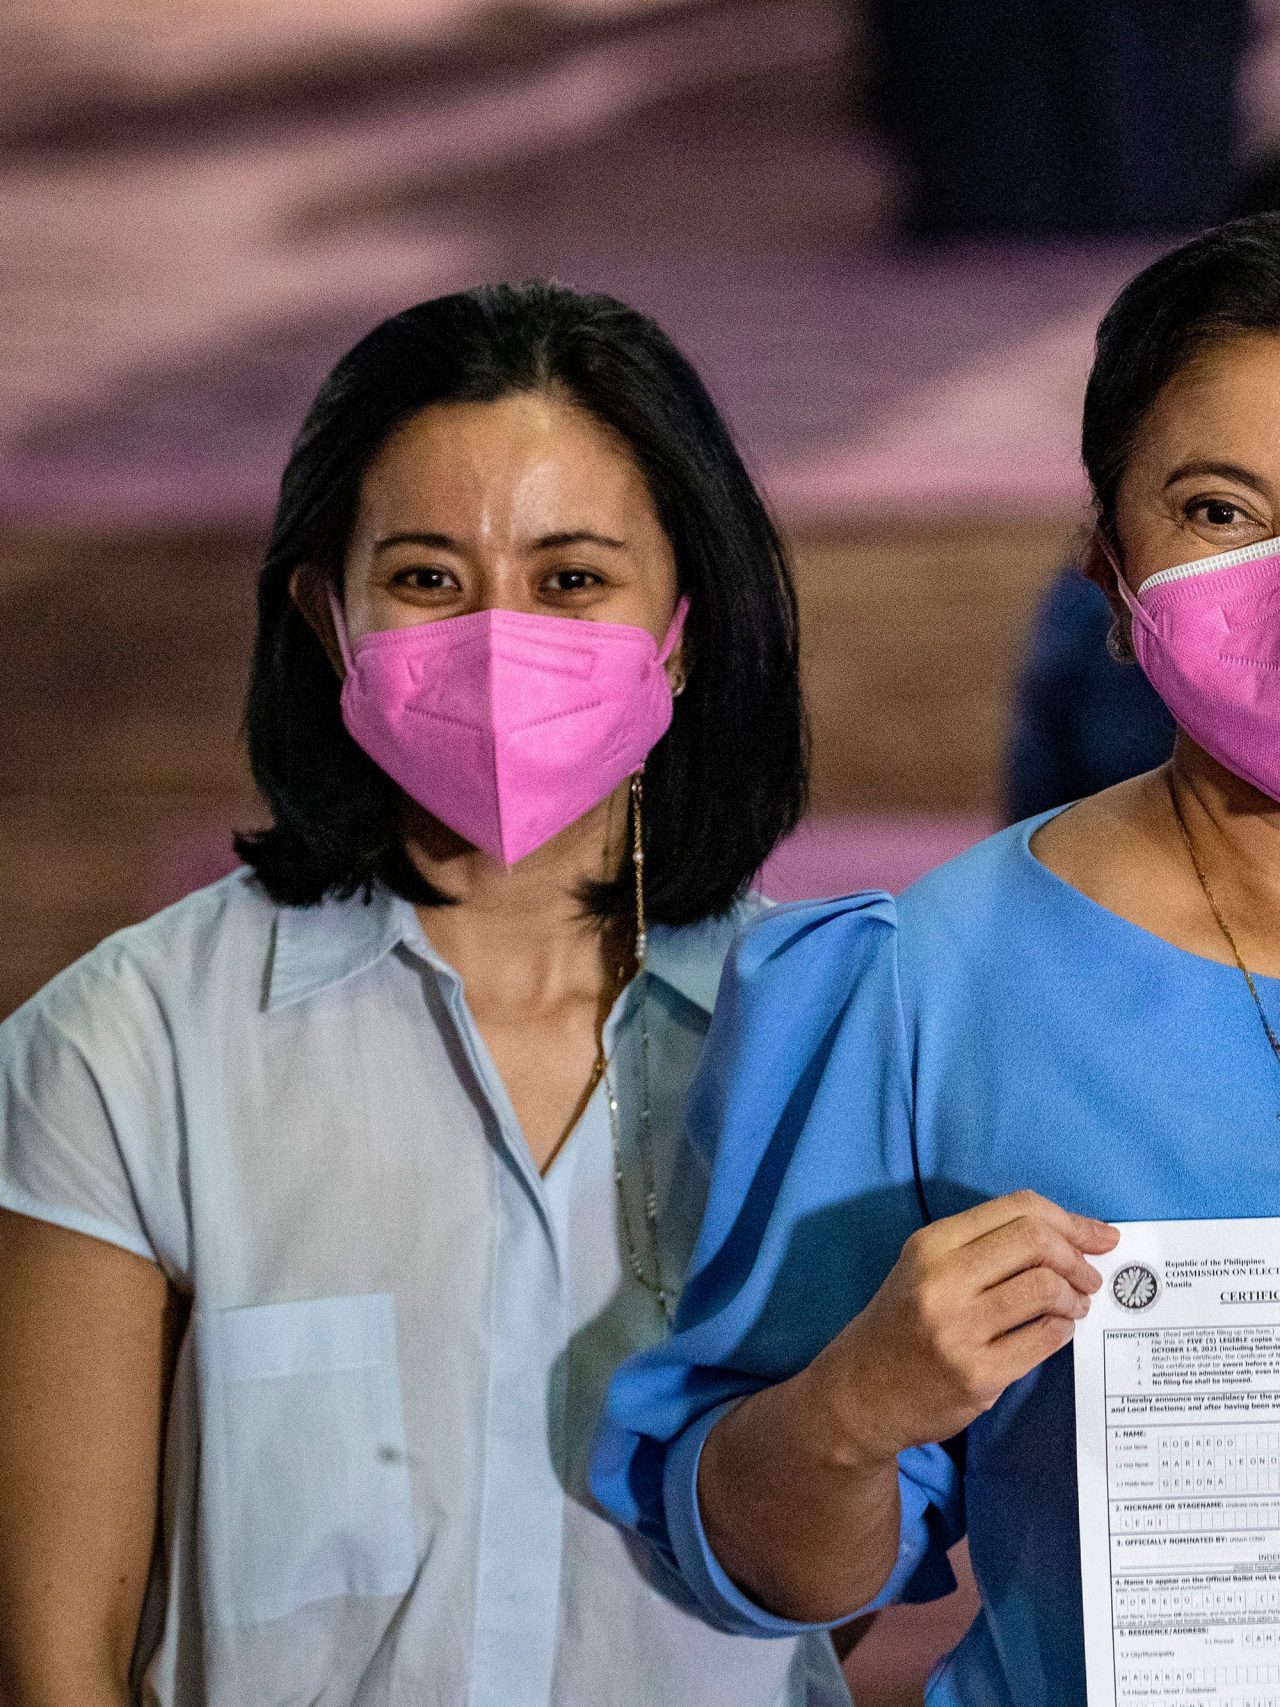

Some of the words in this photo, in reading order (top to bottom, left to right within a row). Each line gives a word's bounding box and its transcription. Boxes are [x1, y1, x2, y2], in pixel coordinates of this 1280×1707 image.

[1165, 1260, 1198, 1269] Republic
[1200, 1259, 1208, 1267] of
[1224, 1258, 1265, 1268] Philippines
[1165, 1268, 1230, 1277] COMMISSION
[1232, 1268, 1246, 1276] ON
[1166, 1280, 1192, 1288] Manila
[1106, 1331, 1161, 1339] INSTRUCTIONS
[1251, 1336, 1272, 1344] copies
[1219, 1345, 1254, 1354] (including
[1163, 1379, 1181, 1387] filing
[1126, 1397, 1153, 1405] hereby
[1207, 1395, 1245, 1403] candidacy
[1224, 1403, 1250, 1412] having
[1123, 1429, 1146, 1439] NAME:
[1178, 1502, 1223, 1510] STAGENAME:
[1125, 1538, 1167, 1546] OFFICIALLY
[1169, 1536, 1214, 1545] NOMINATED
